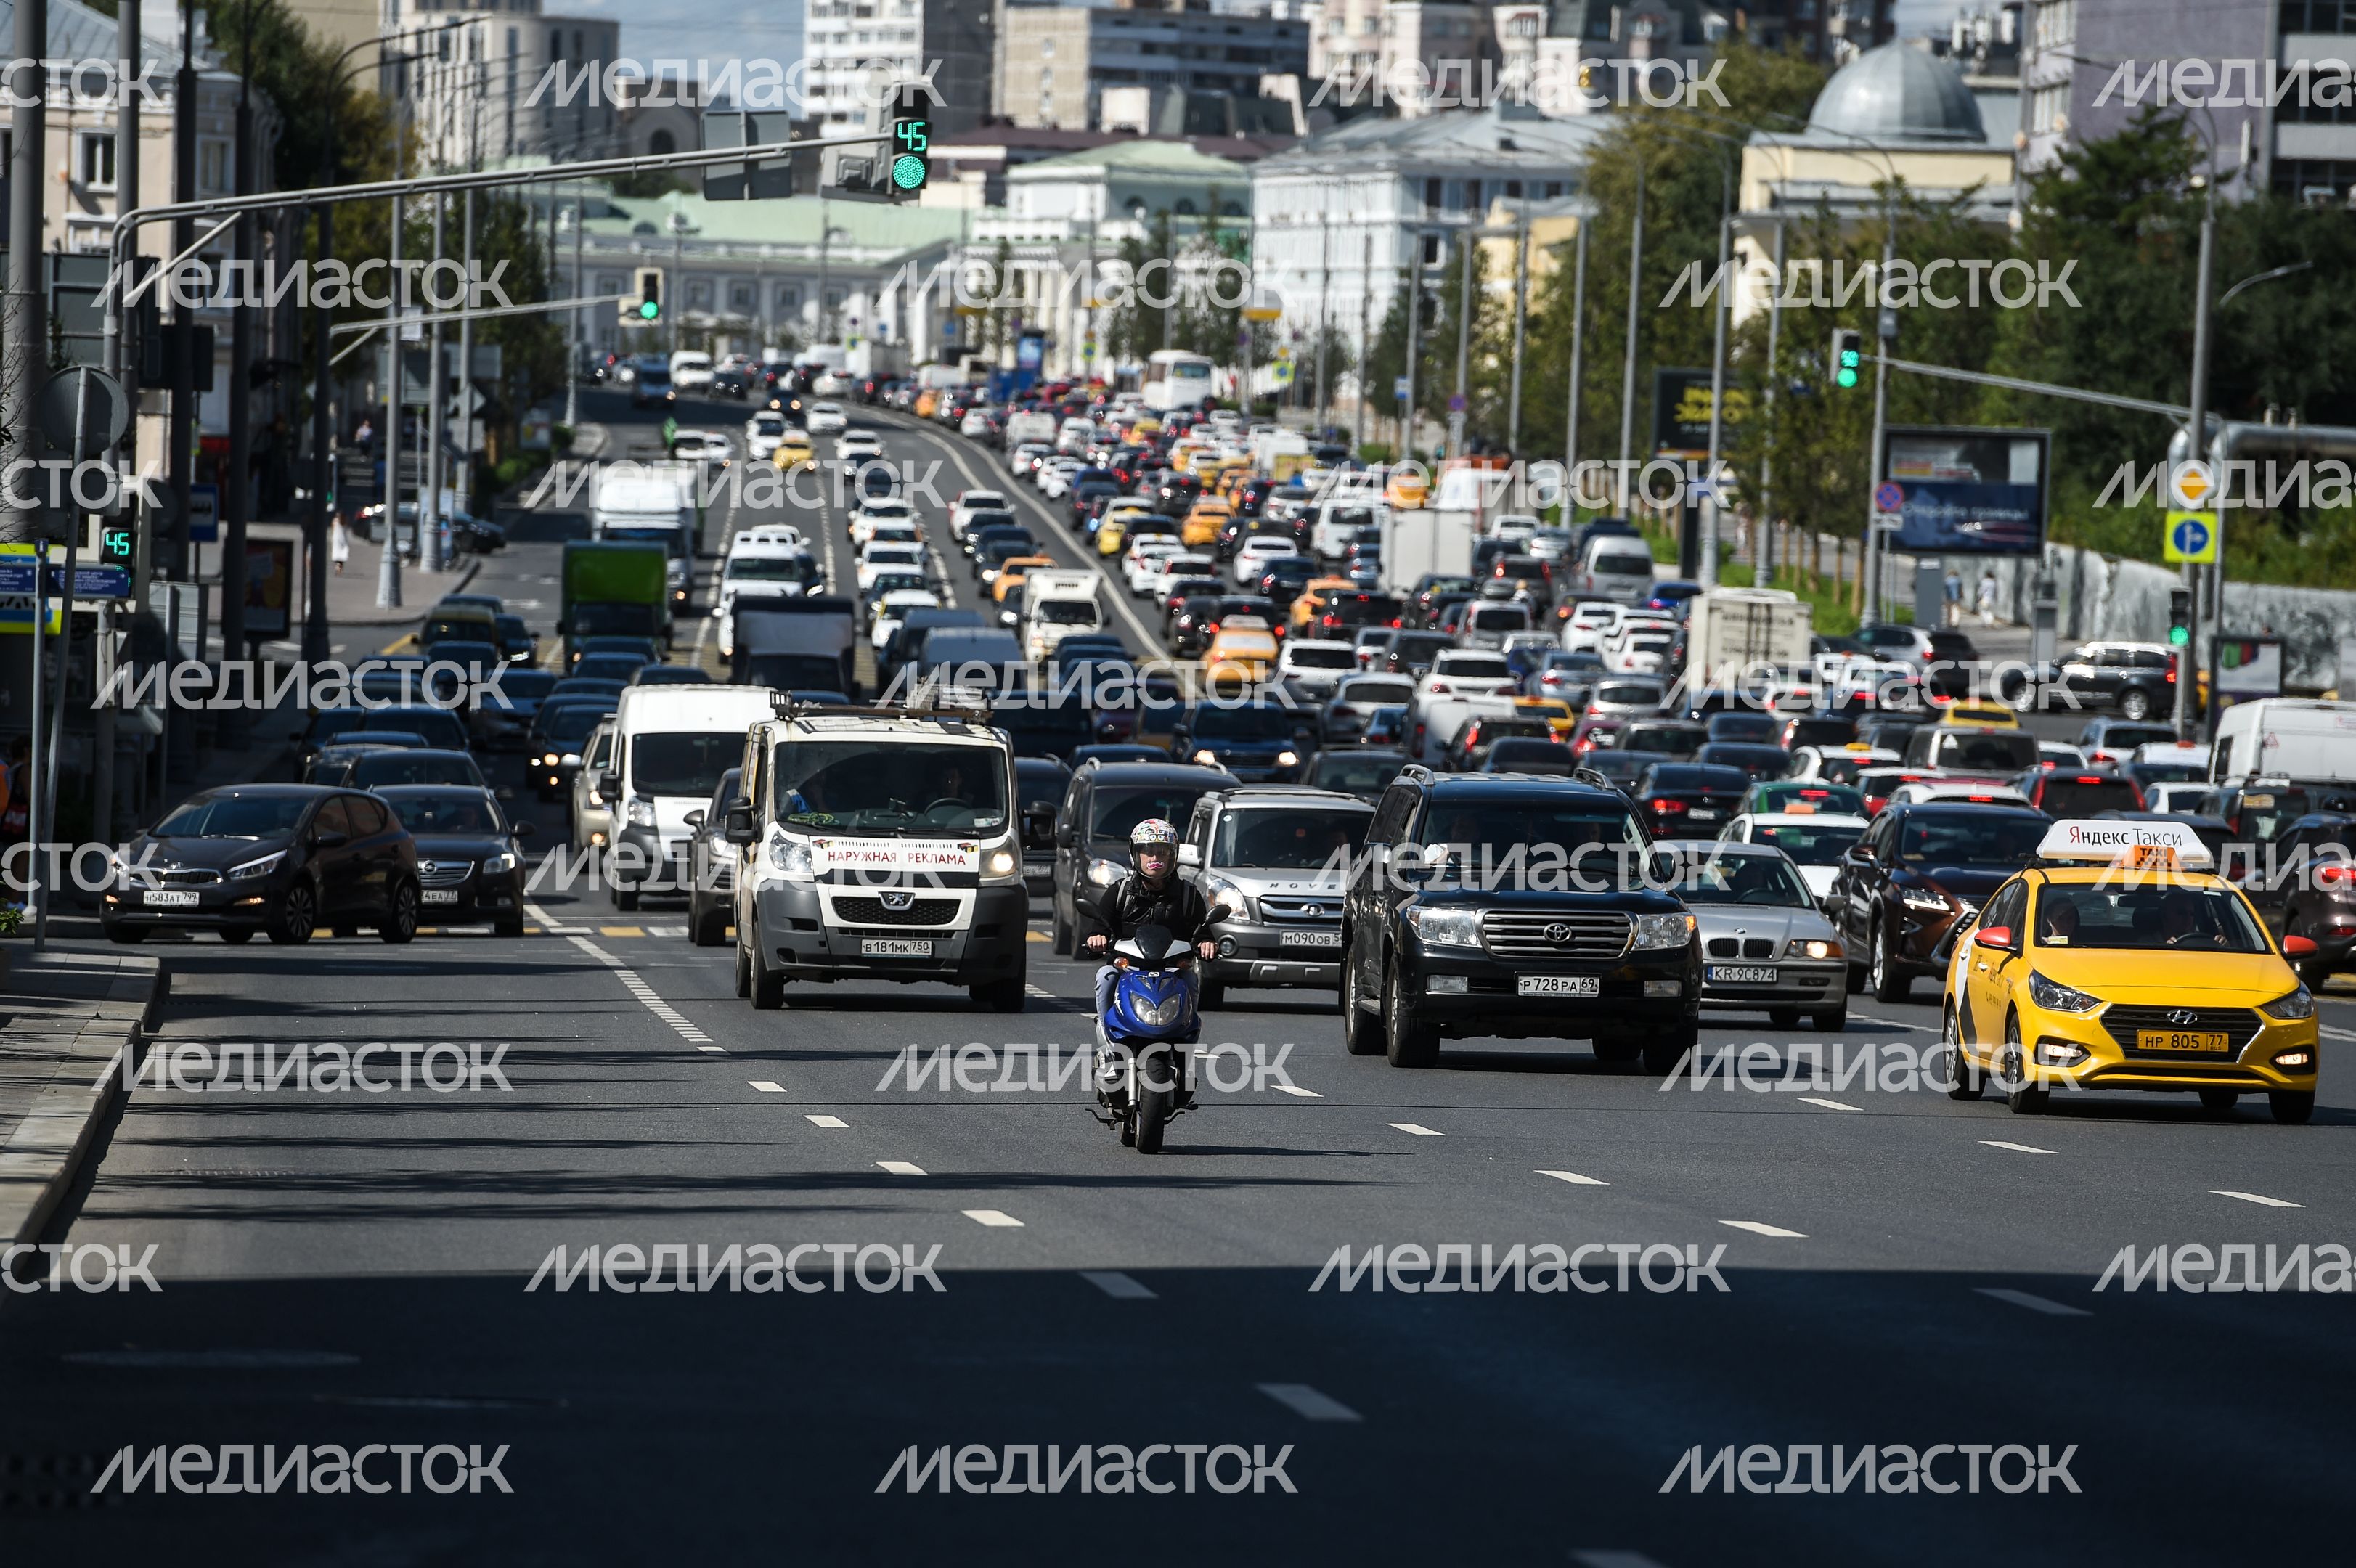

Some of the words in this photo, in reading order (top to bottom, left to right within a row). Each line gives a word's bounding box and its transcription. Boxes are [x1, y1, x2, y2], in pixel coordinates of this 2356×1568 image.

[898, 122, 926, 151] 45
[106, 533, 129, 555] 45
[2069, 826, 2130, 845] Яндекс
[2132, 828, 2182, 846] Такси
[828, 852, 897, 863] НАРУЖНАЯ
[908, 852, 966, 865] РЕКЛАМА
[2209, 1034, 2223, 1045] 77
